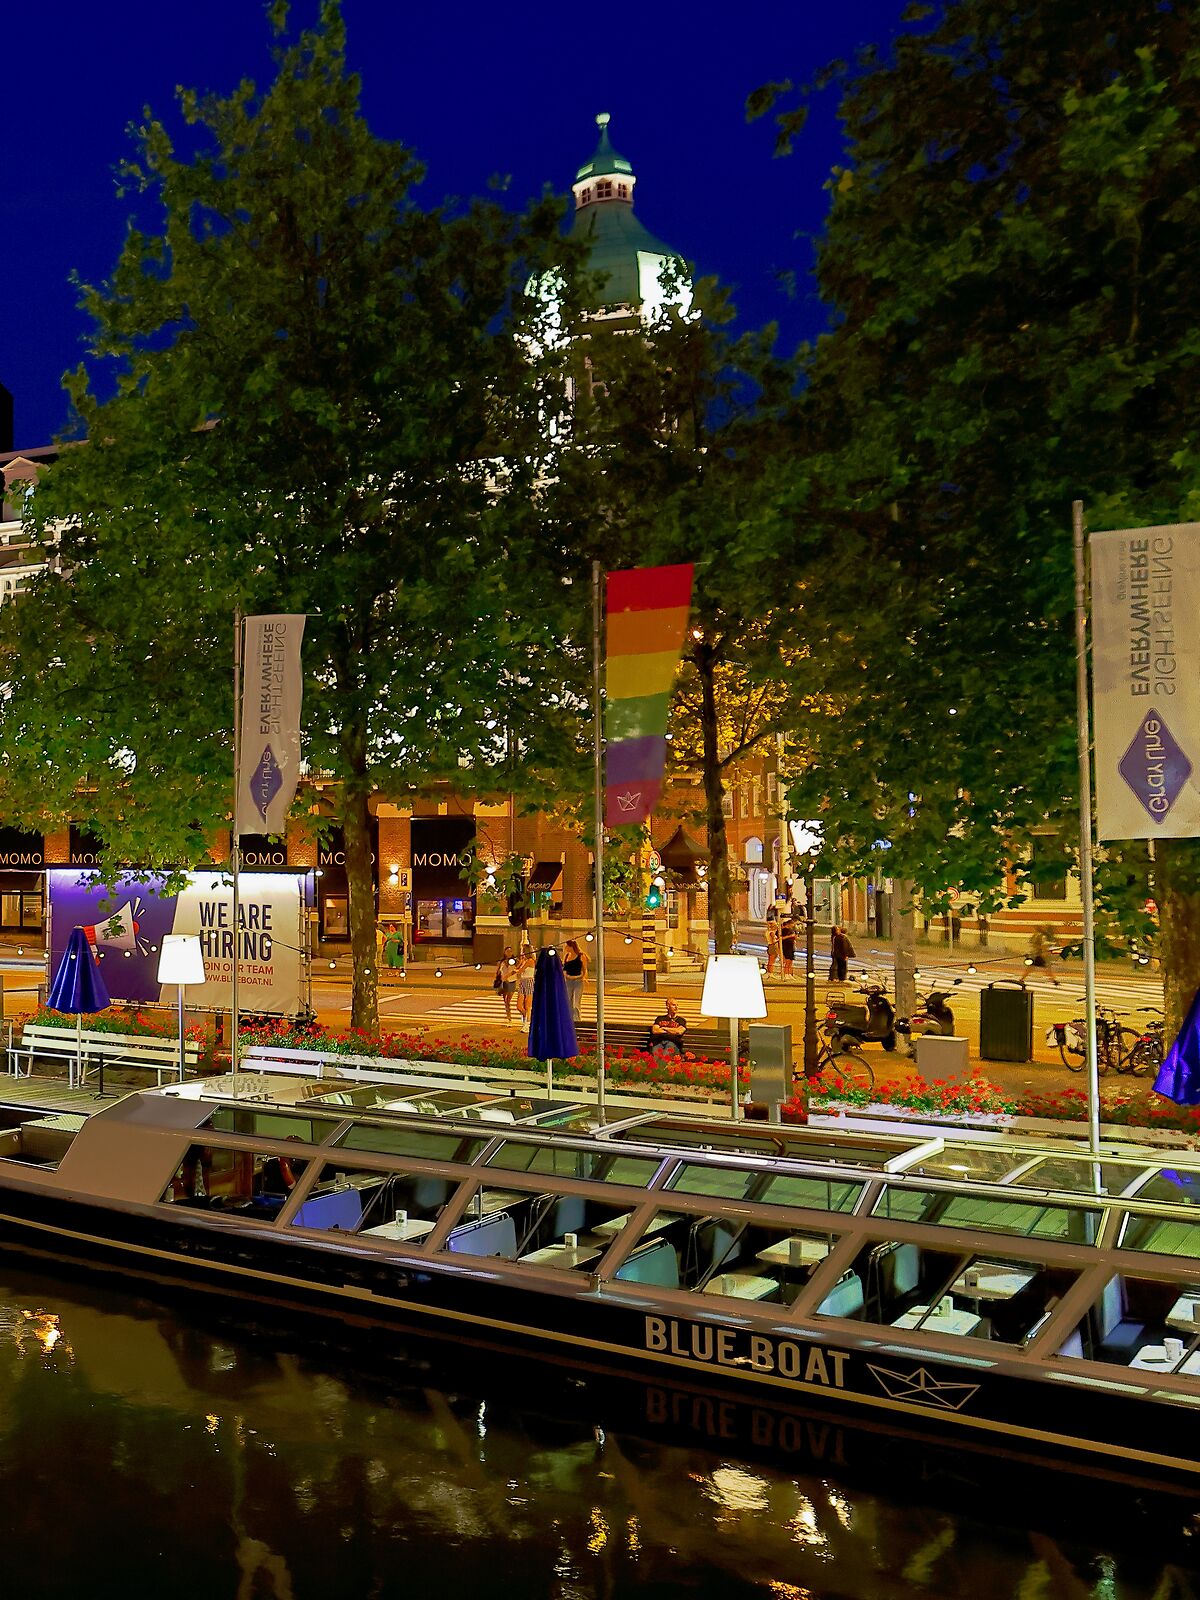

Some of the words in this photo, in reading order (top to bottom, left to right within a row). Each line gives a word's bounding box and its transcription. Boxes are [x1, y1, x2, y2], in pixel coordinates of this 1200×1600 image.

[413, 853, 472, 866] MOMO
[199, 902, 228, 928] WE
[238, 903, 272, 930] ARE
[199, 930, 272, 961] HIRING
[204, 962, 221, 971] OIN
[223, 963, 244, 973] OR
[246, 964, 274, 975] TEAM
[645, 1315, 737, 1366] BLUE
[751, 1335, 850, 1388] BOAT
